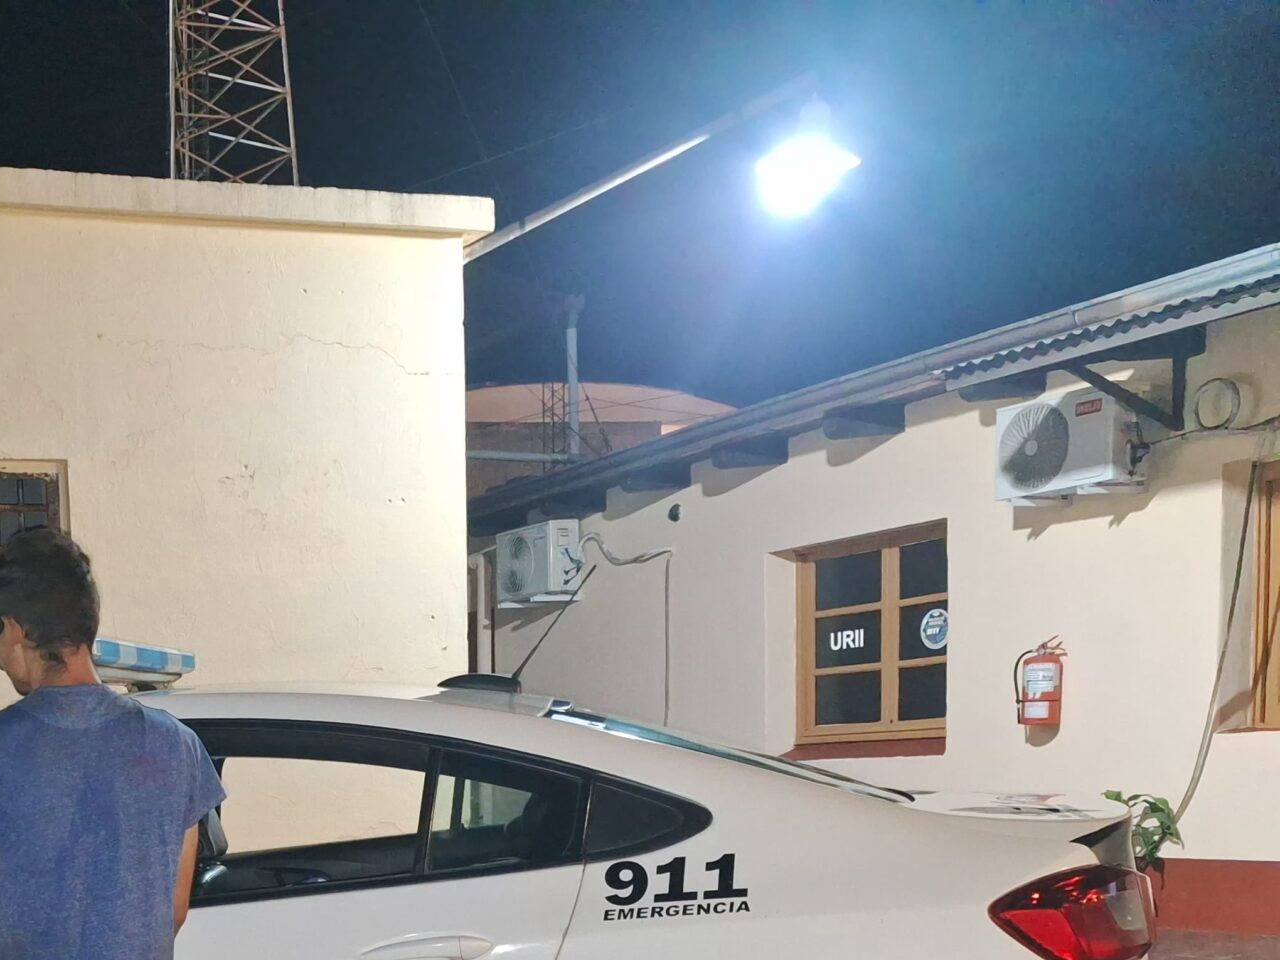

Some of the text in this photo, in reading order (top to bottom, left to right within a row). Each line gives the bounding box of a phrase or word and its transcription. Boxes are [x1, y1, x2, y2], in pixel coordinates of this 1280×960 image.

[830, 628, 864, 651] URII
[604, 853, 749, 906] 911
[603, 901, 751, 921] EMERGENCIA
